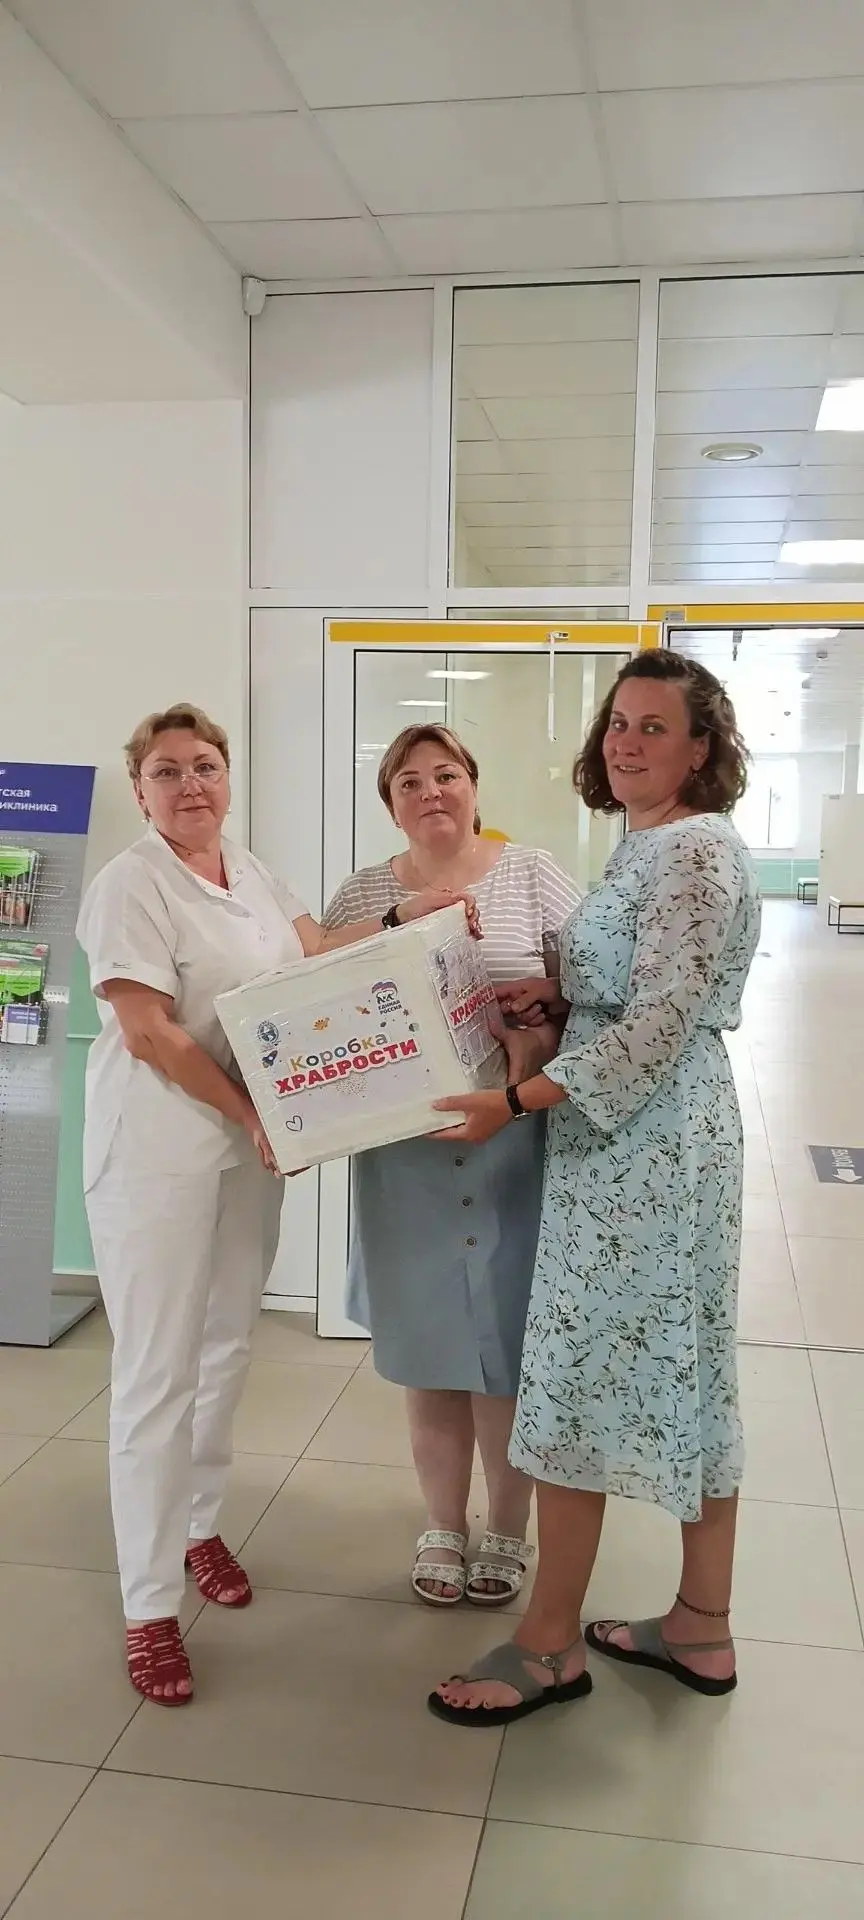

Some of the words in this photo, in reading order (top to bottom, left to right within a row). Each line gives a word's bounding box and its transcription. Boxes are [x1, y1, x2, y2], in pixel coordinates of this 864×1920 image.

[380, 1004, 402, 1015] РОССИЯ
[275, 1039, 418, 1094] ХРАБРОСТИ
[289, 1033, 388, 1071] Коробка
